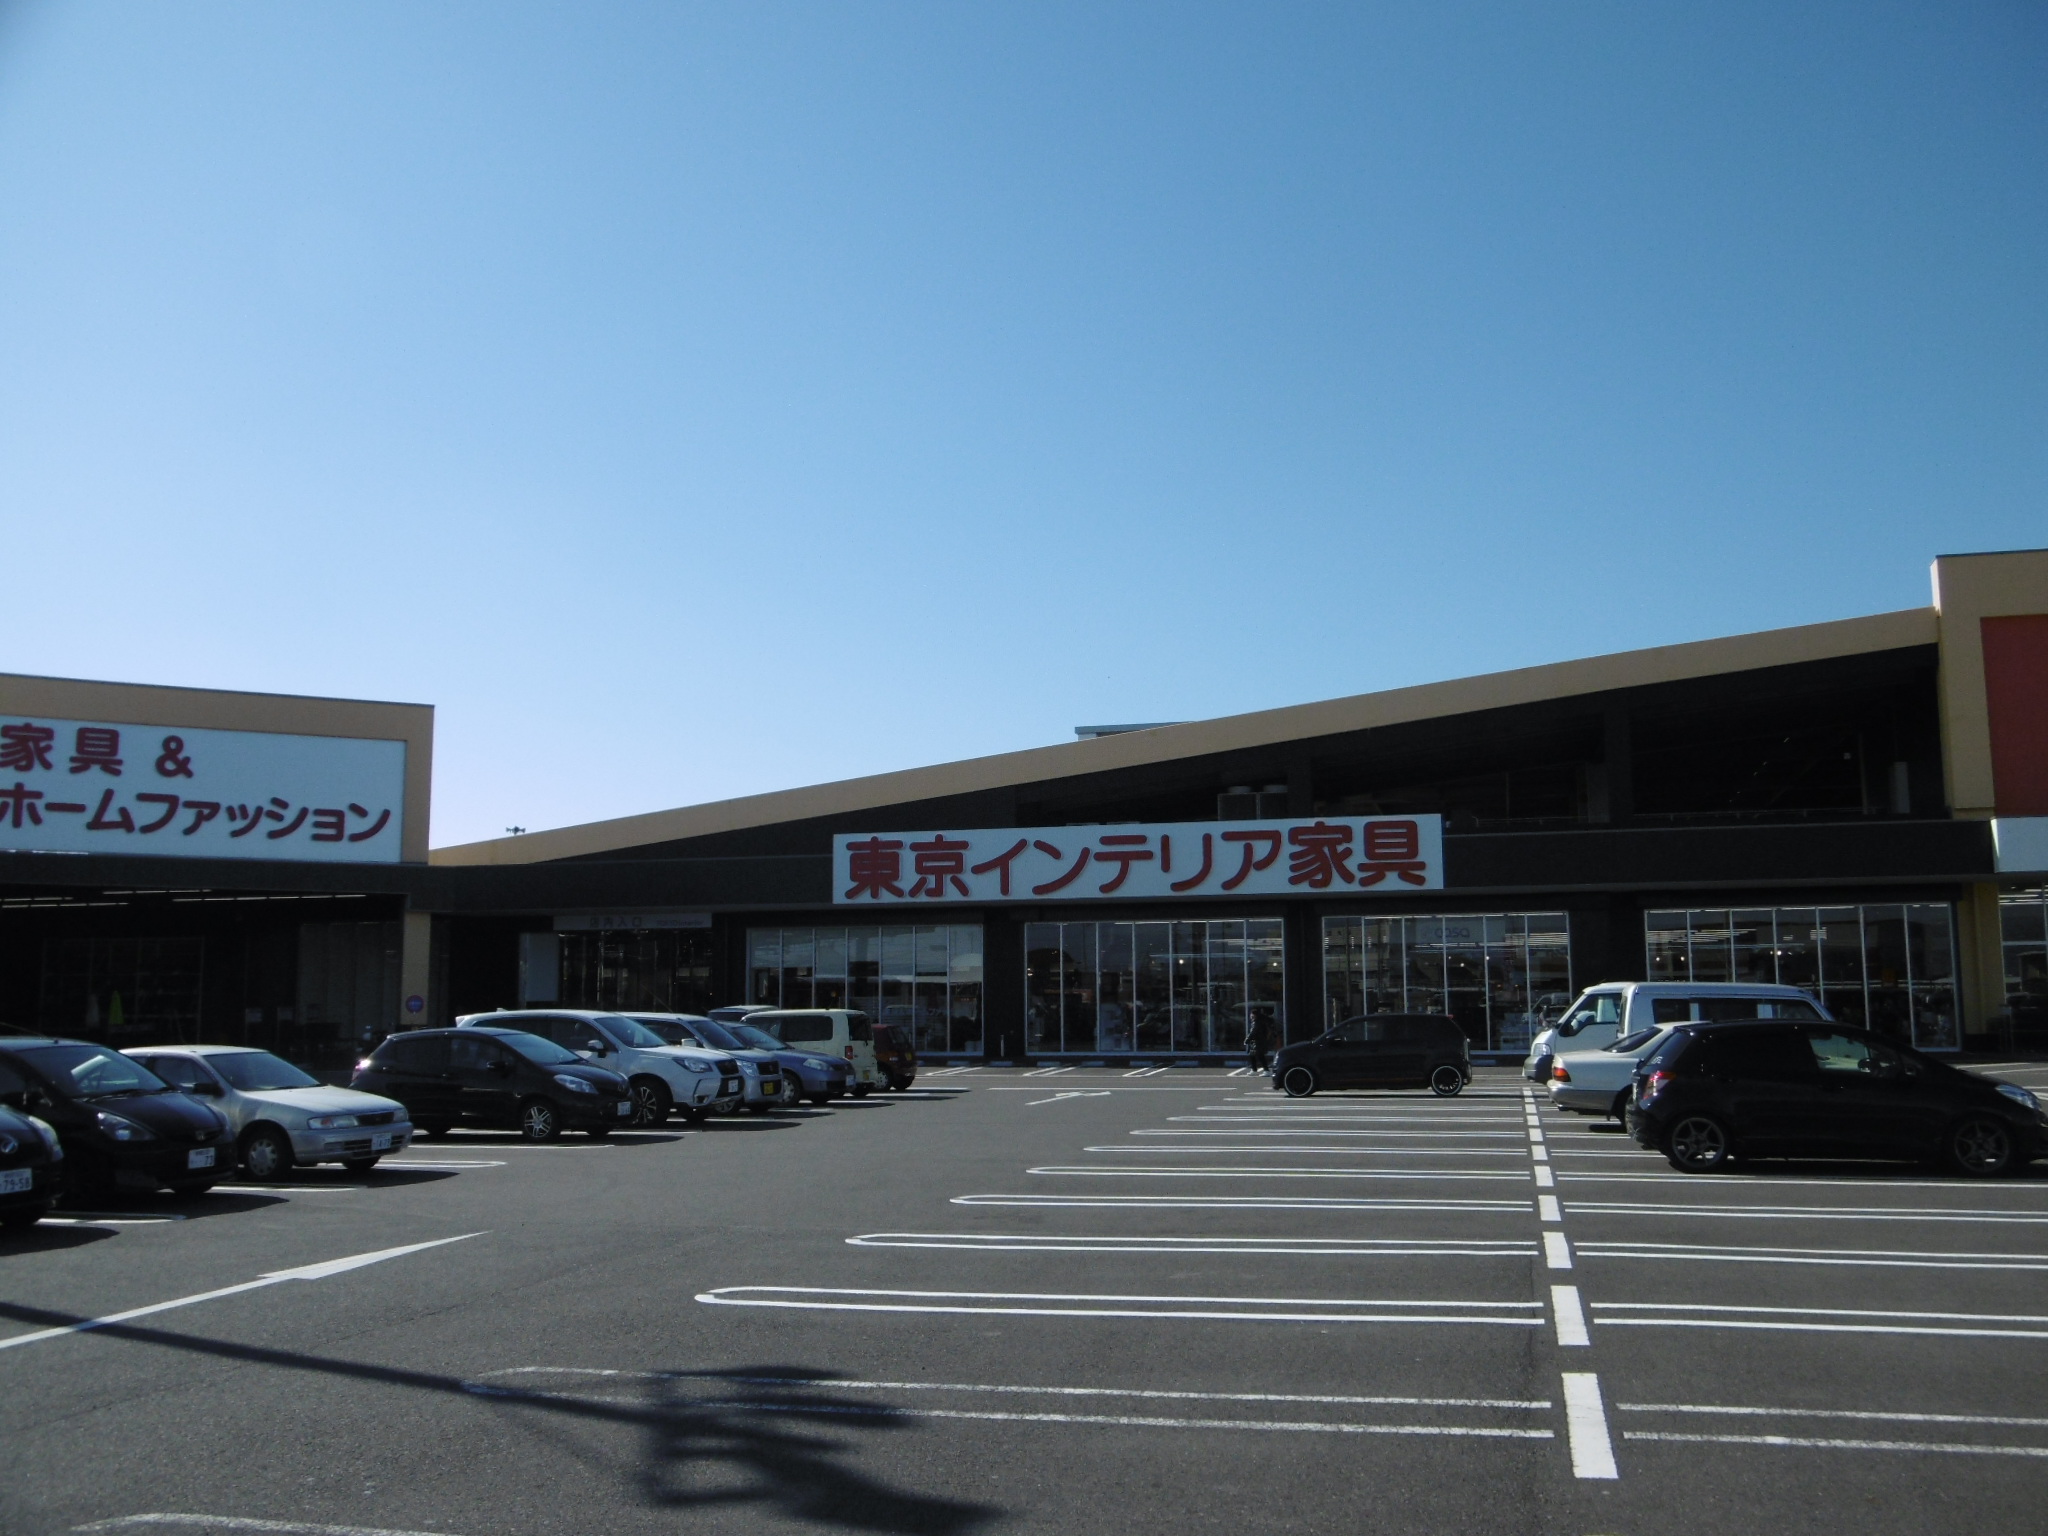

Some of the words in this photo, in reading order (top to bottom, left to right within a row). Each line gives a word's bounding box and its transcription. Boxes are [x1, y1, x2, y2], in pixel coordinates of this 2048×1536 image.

[0, 723, 123, 776] 家具
[155, 736, 194, 778] &
[0, 782, 391, 842] ホームファッション
[847, 823, 1427, 898] 東京インテリア家具
